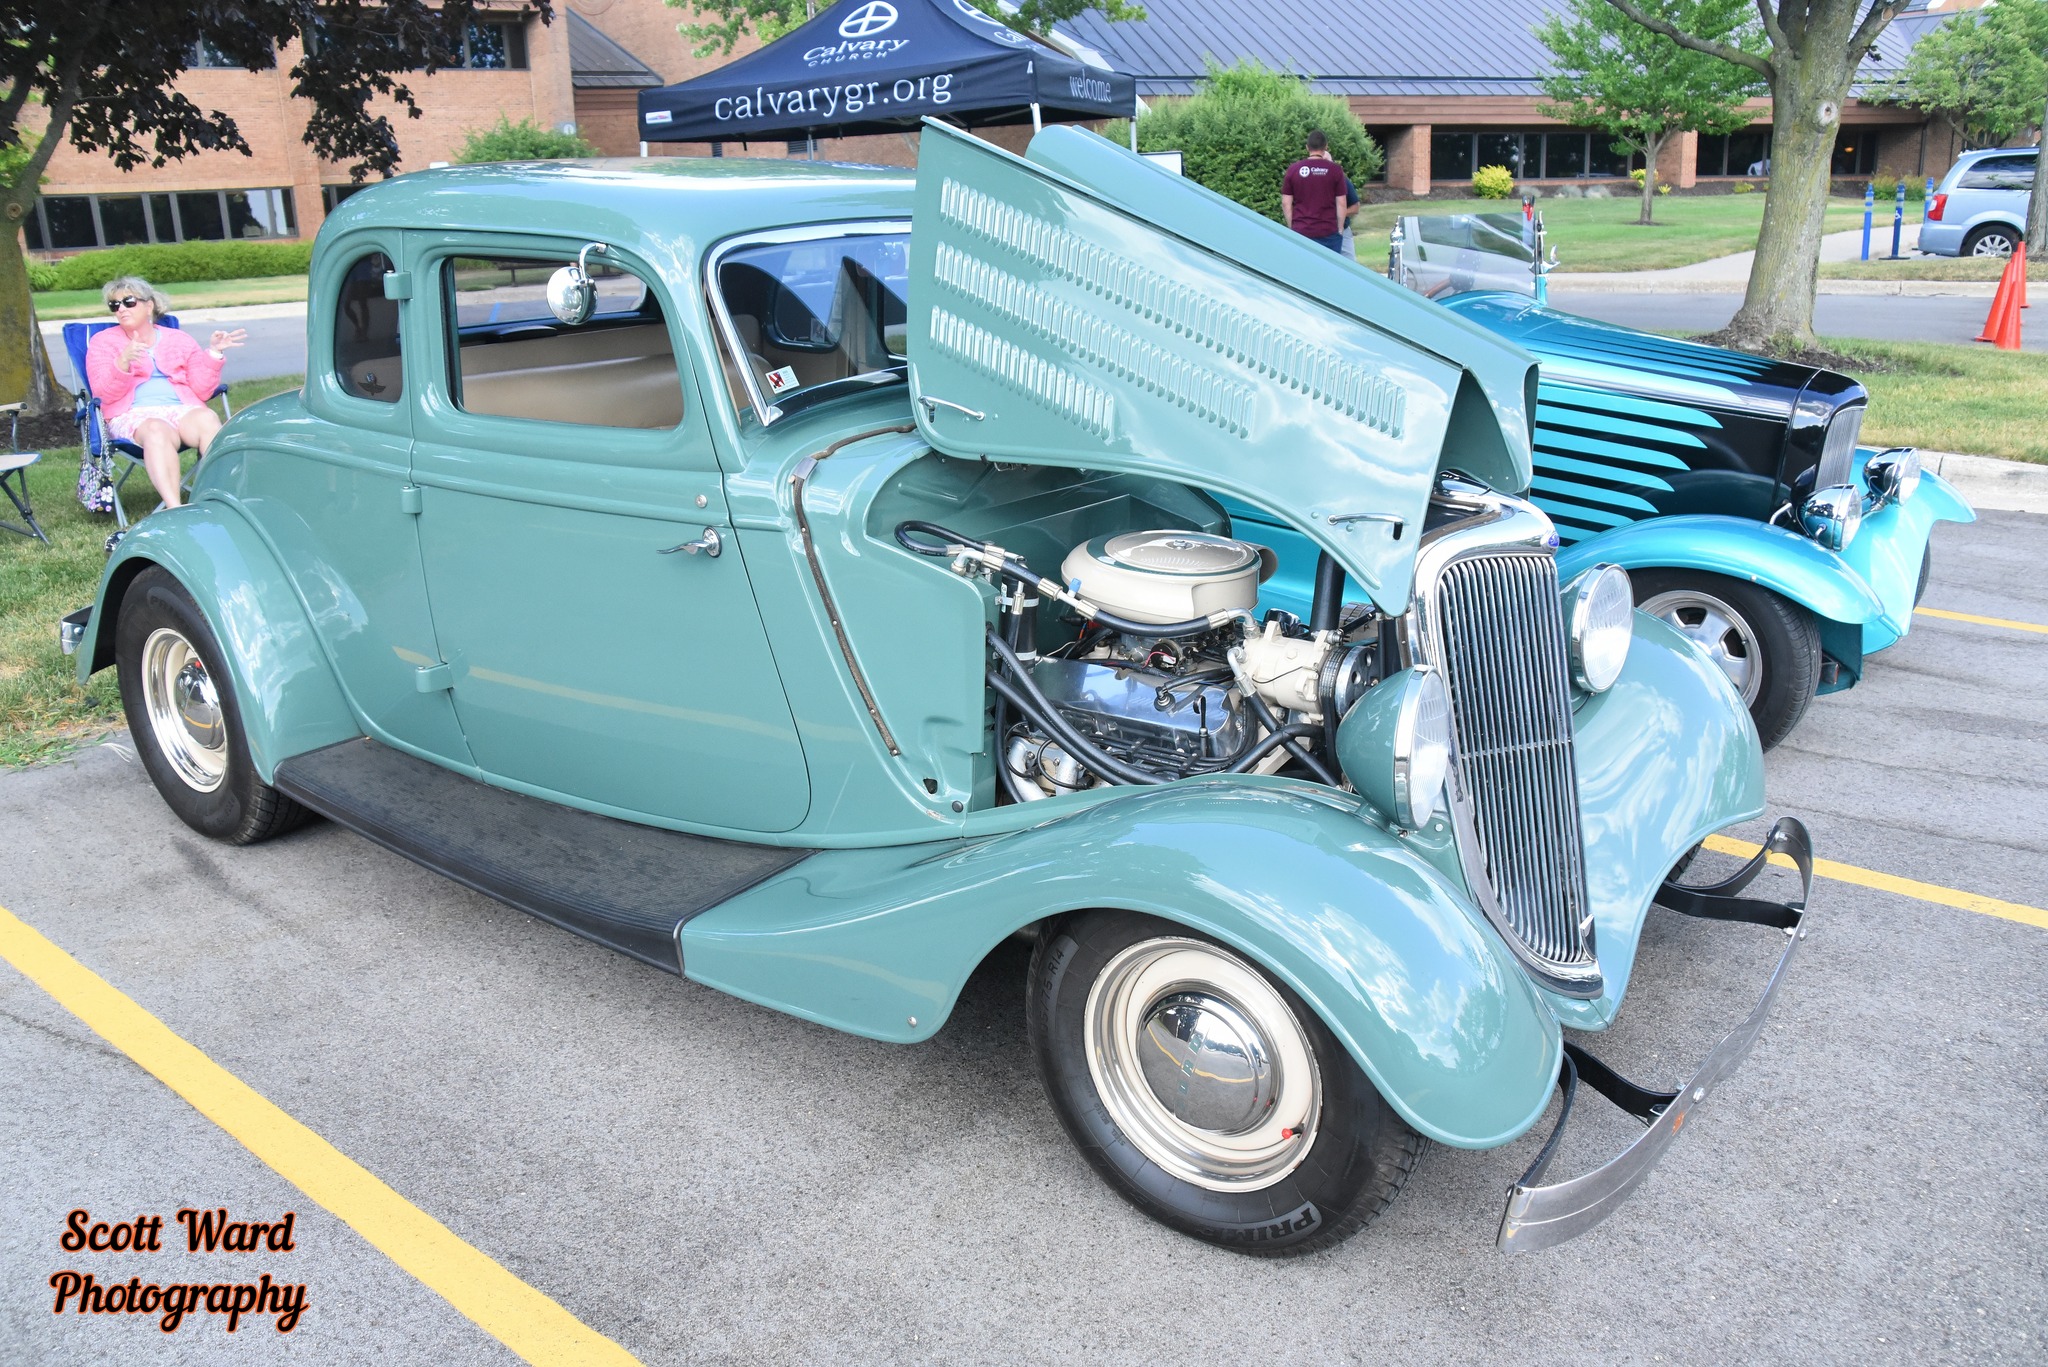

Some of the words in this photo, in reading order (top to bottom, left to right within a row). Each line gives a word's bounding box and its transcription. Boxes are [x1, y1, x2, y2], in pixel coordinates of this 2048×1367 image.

[803, 39, 910, 62] Calvary
[807, 51, 888, 68] CHURCH
[714, 73, 953, 121] calvarygr.org
[1069, 68, 1112, 104] welcome
